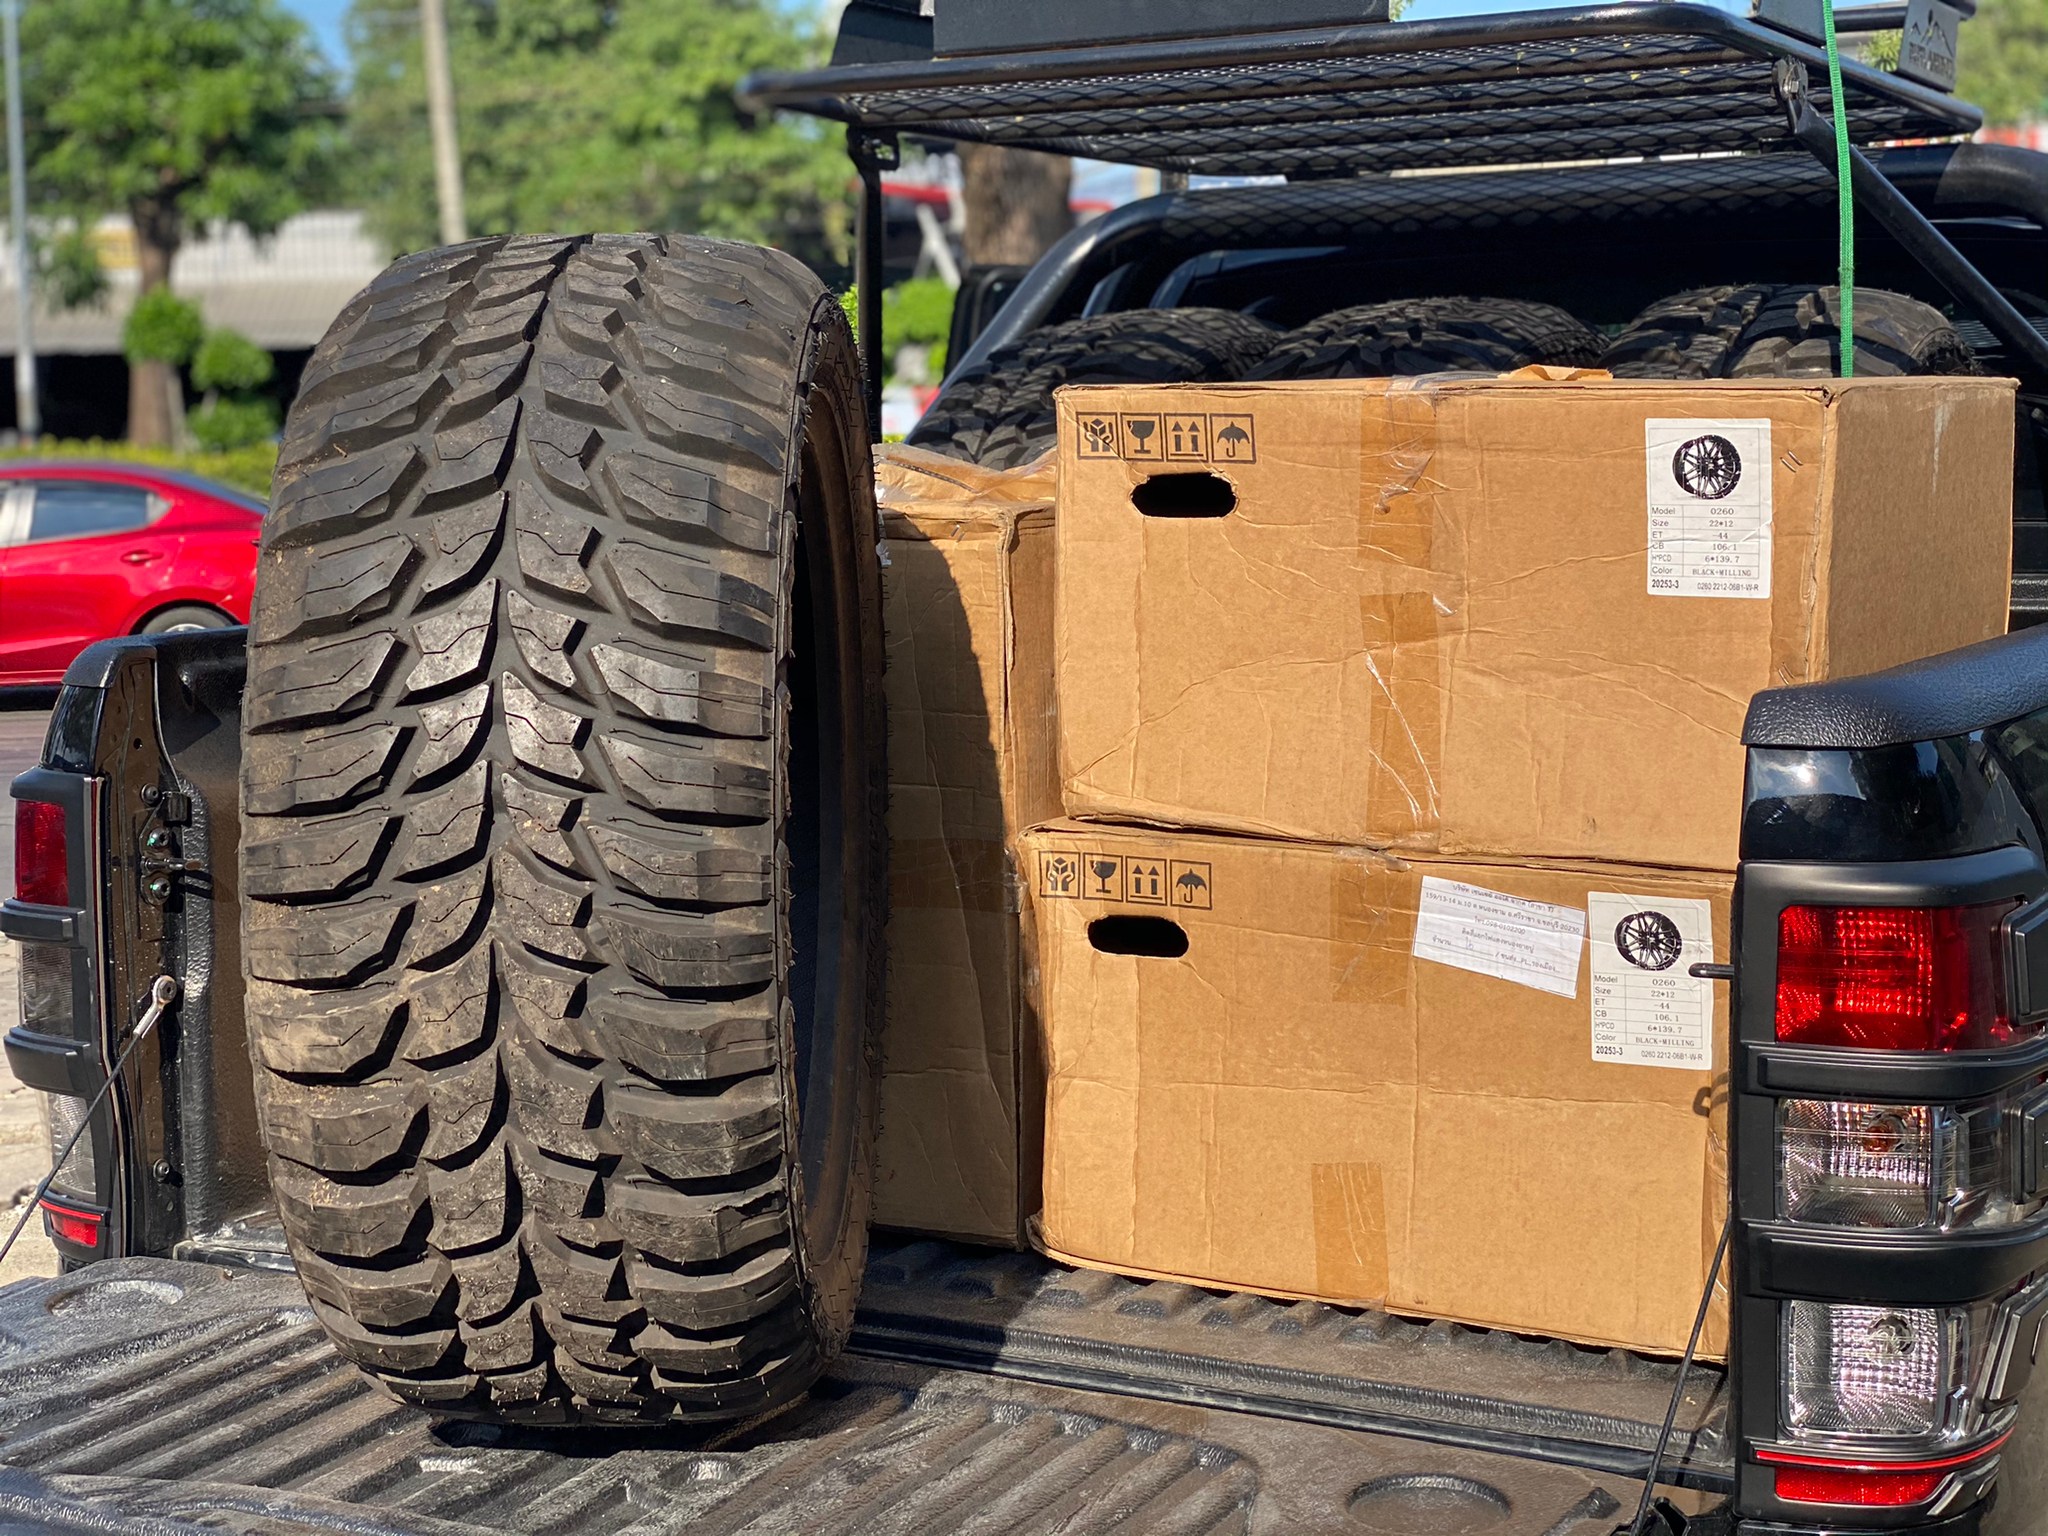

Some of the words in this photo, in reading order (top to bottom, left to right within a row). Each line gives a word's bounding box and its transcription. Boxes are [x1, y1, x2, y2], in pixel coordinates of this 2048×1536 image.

[1652, 579, 1679, 588] 20253-3
[1595, 987, 1611, 995] Size
[1596, 1046, 1623, 1056] 20253-3
